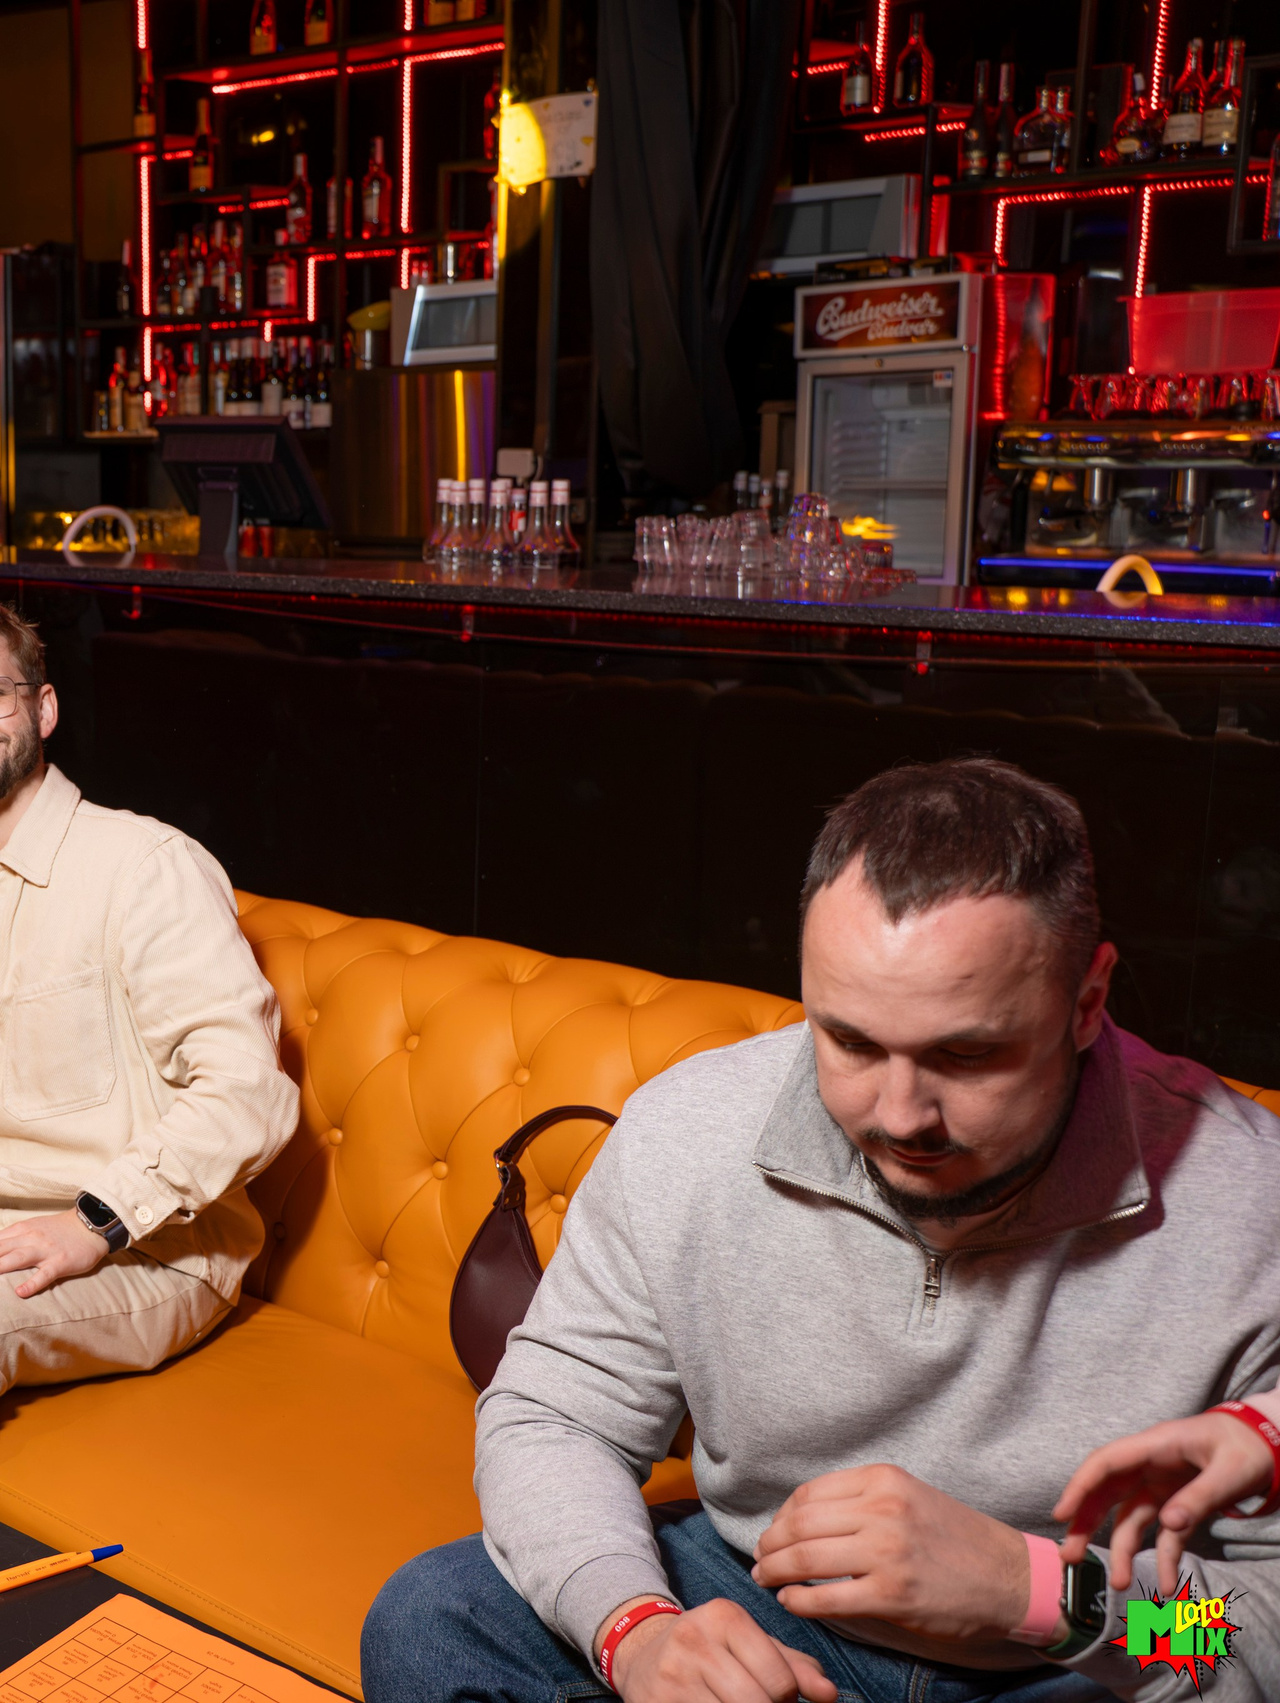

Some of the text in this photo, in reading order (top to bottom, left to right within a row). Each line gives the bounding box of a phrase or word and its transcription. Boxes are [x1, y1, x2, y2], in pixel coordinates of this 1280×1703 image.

[816, 291, 945, 341] Budweiser
[867, 317, 939, 341] Budvar
[614, 1616, 631, 1632] 098
